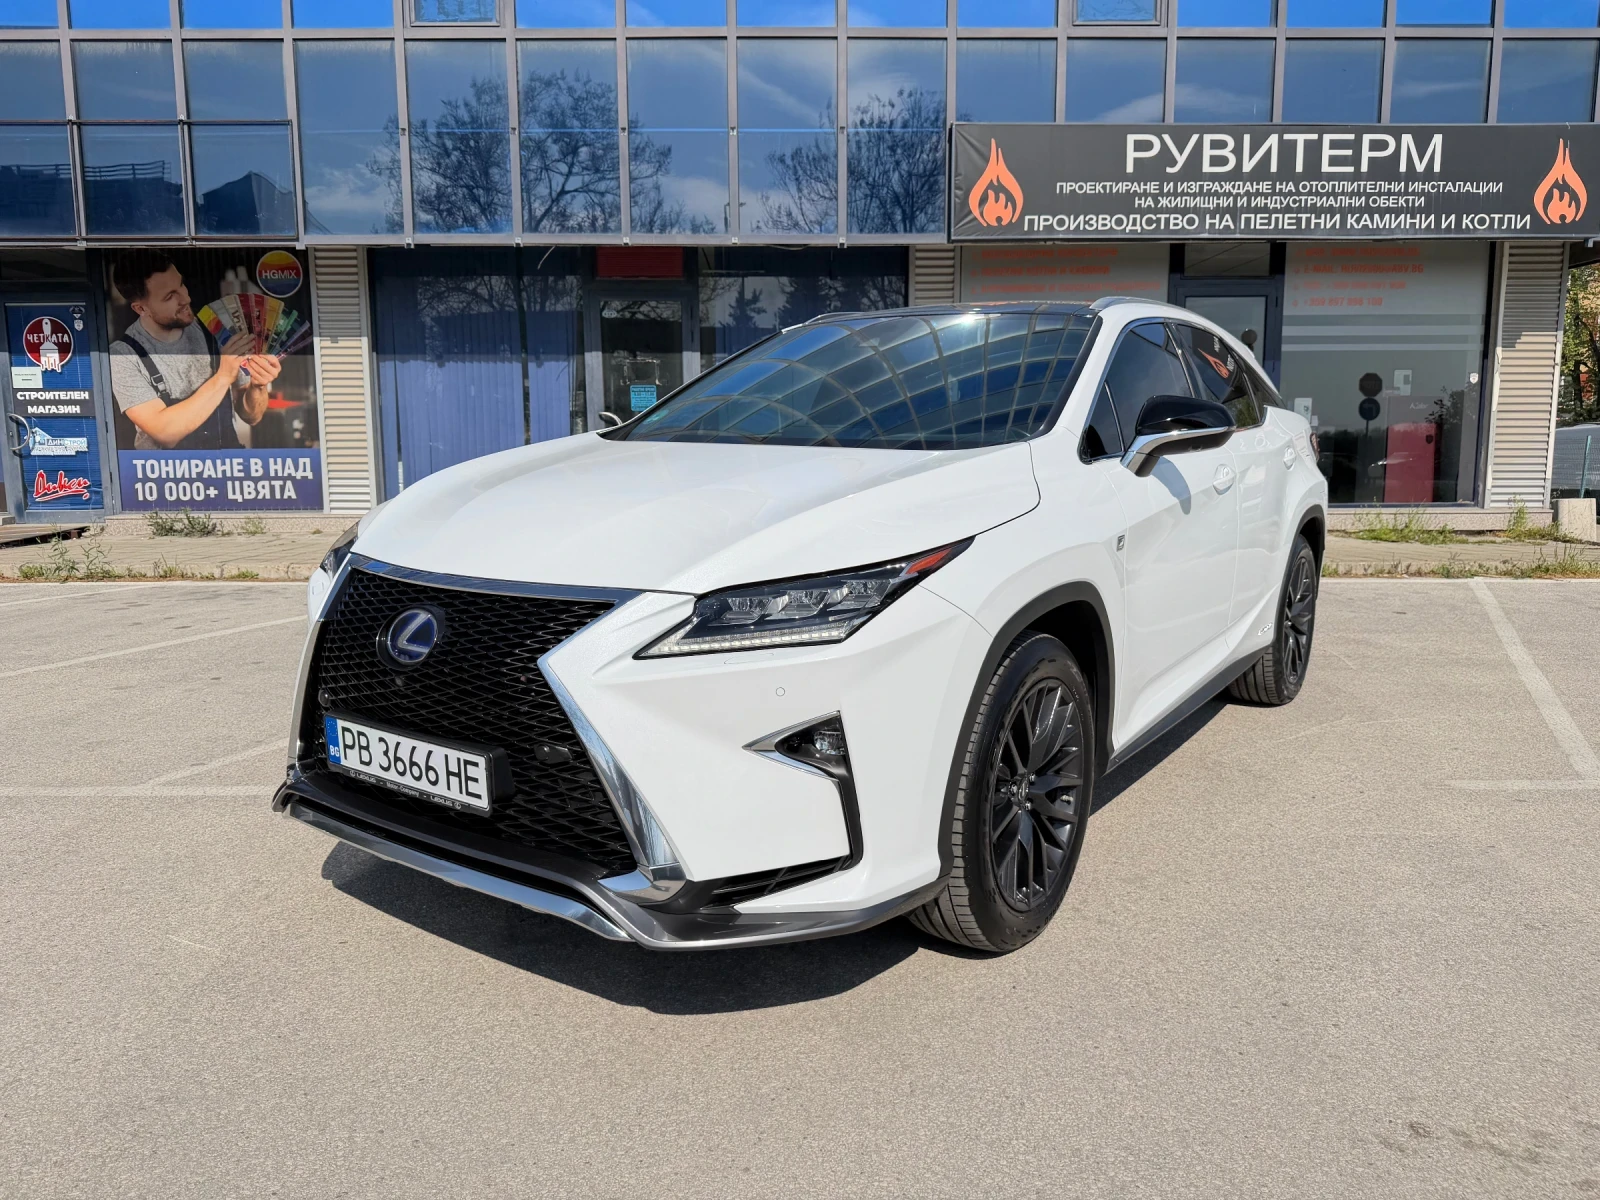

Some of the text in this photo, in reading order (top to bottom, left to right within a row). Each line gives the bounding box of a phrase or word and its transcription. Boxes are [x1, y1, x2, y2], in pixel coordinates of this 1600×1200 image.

[1125, 133, 1443, 174] РУВИТЕРМ
[1056, 181, 1503, 196] ПРОЕКТИРАНЕ И ИЗГРАЖДАНЕ НА ОТОПЛИТЕЛНИ ИНСТАЛАЦИИ
[1134, 195, 1425, 211] НА ЖИЛИЩНИ И ИНДУСТРИАЛНИ ОБЕКТИ
[1023, 213, 1531, 234] ПРОИЗВОДСТВО НА ПЕЛЕТНИ КАМИНИ И КОТЛИ
[262, 270, 297, 279] HGMIX
[27, 333, 70, 343] ЧЕТКАТА
[16, 391, 89, 400] СТРОИТЕЛЕН
[27, 405, 81, 414] МАГАЗИН
[132, 457, 314, 480] ТОНИРАНЕ В НАД
[134, 480, 297, 503] 10 000+ ЦВЯТА
[329, 745, 340, 757] BG
[341, 726, 483, 800] PB 3666 HE
